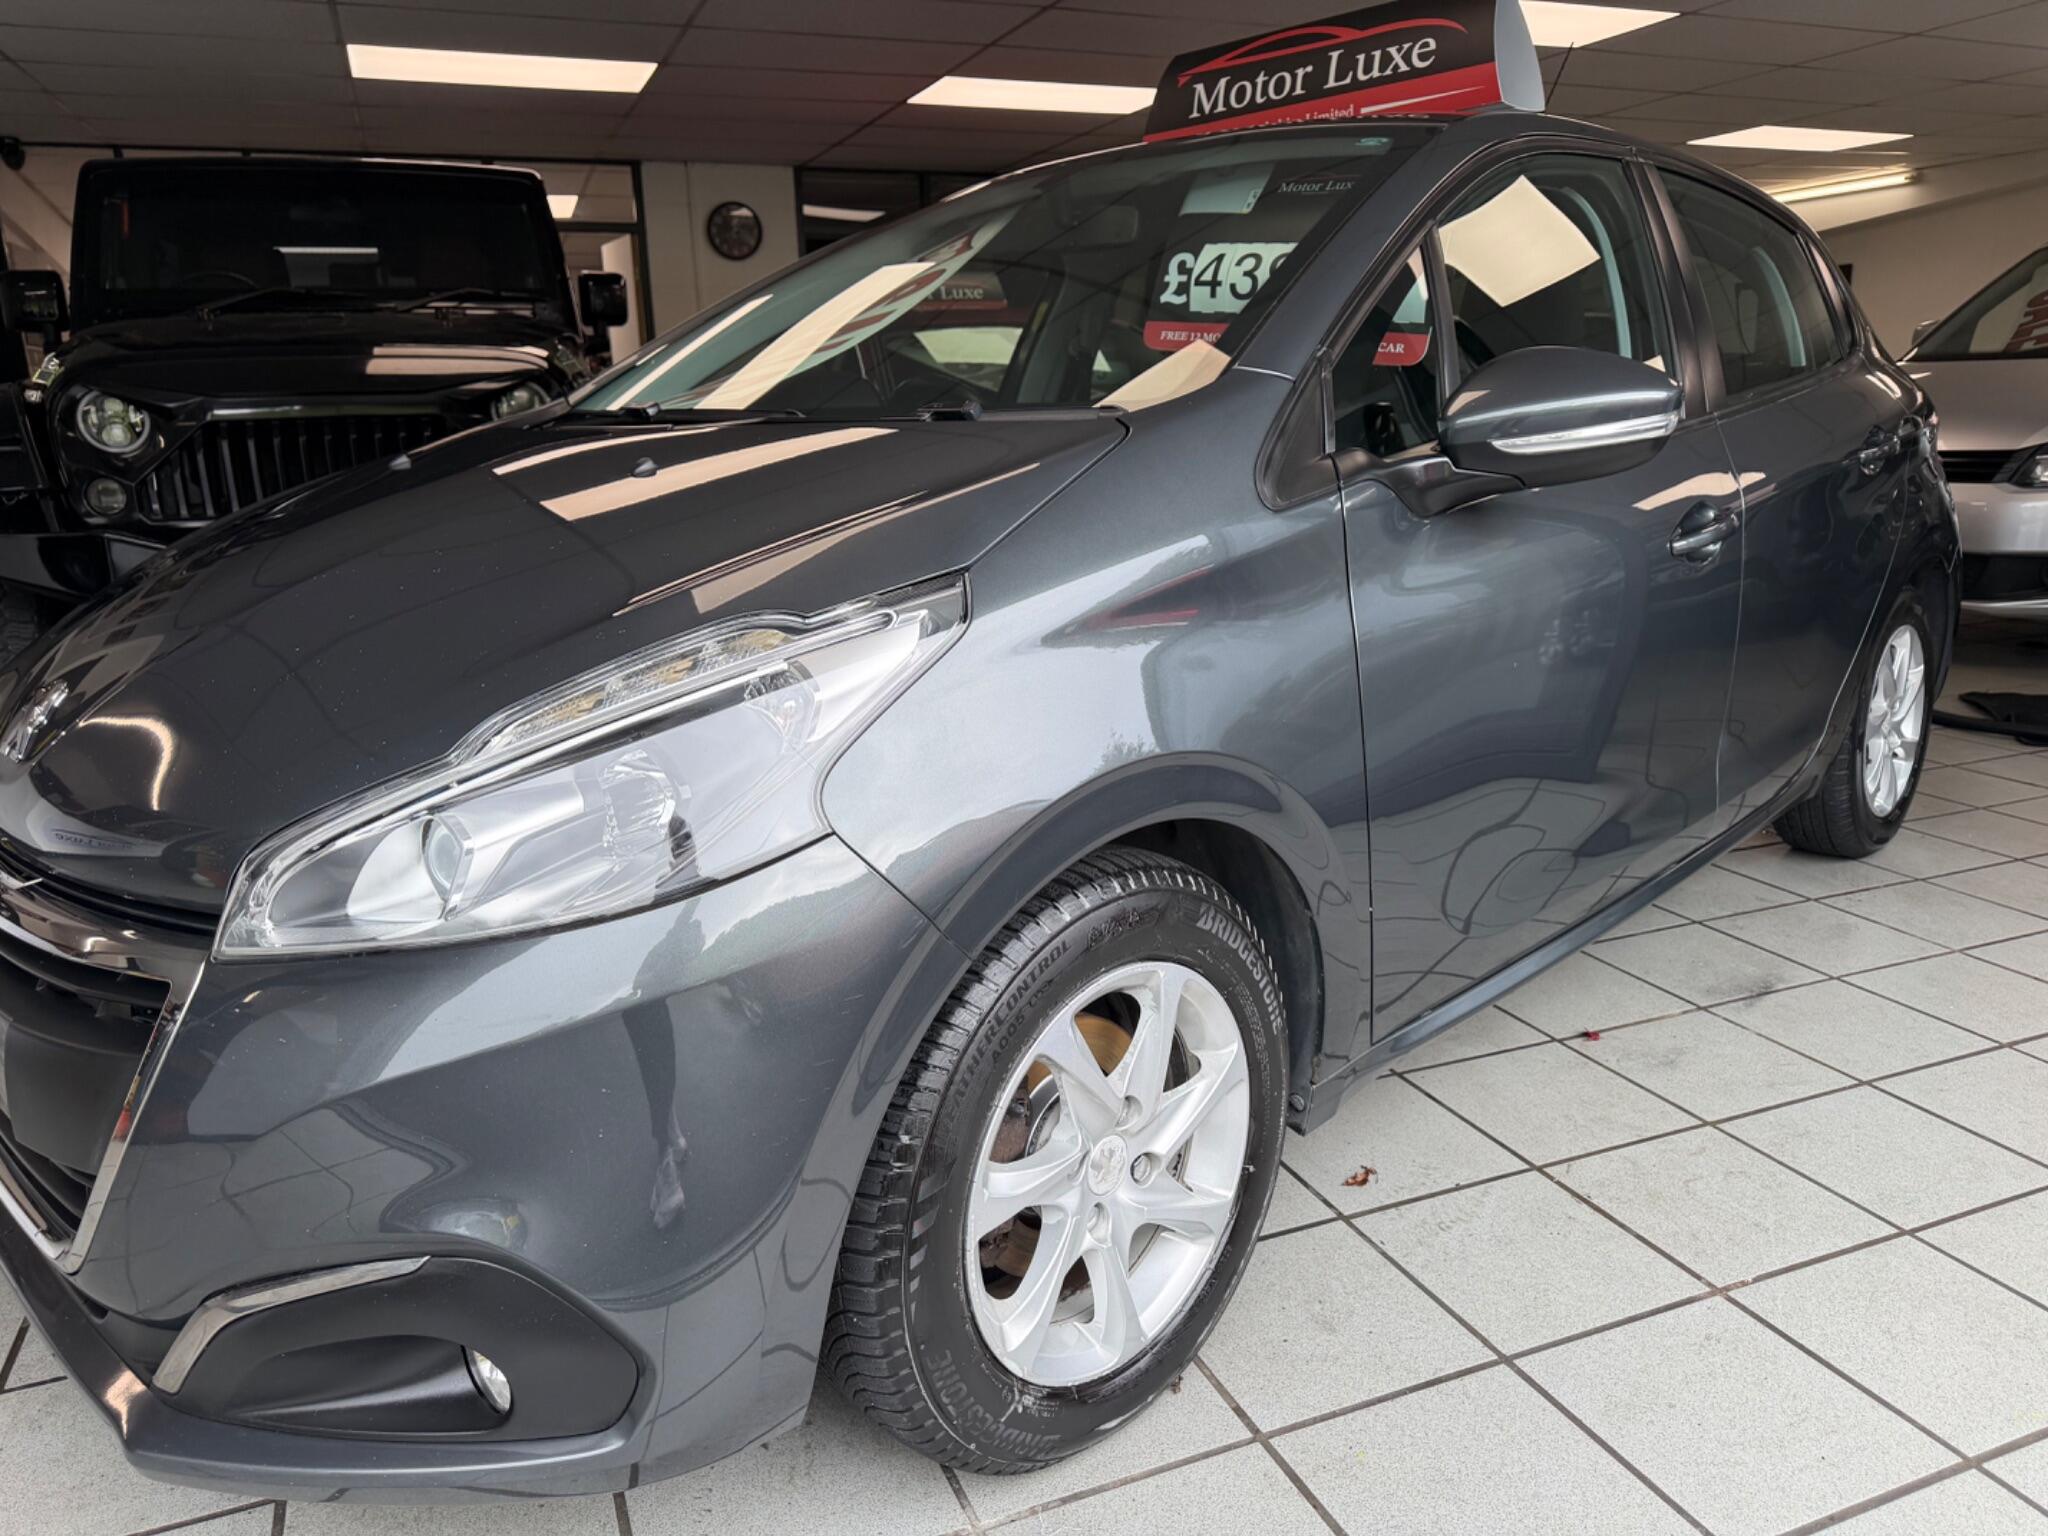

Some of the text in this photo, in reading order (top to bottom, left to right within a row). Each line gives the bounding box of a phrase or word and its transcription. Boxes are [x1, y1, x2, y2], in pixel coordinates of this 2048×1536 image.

[1188, 37, 1438, 119] Motor Luxe
[939, 285, 985, 301] Luxe
[1160, 330, 1189, 341] FREE
[1377, 342, 1405, 354] CAR
[1196, 903, 1283, 1035] BRIDGESTONE
